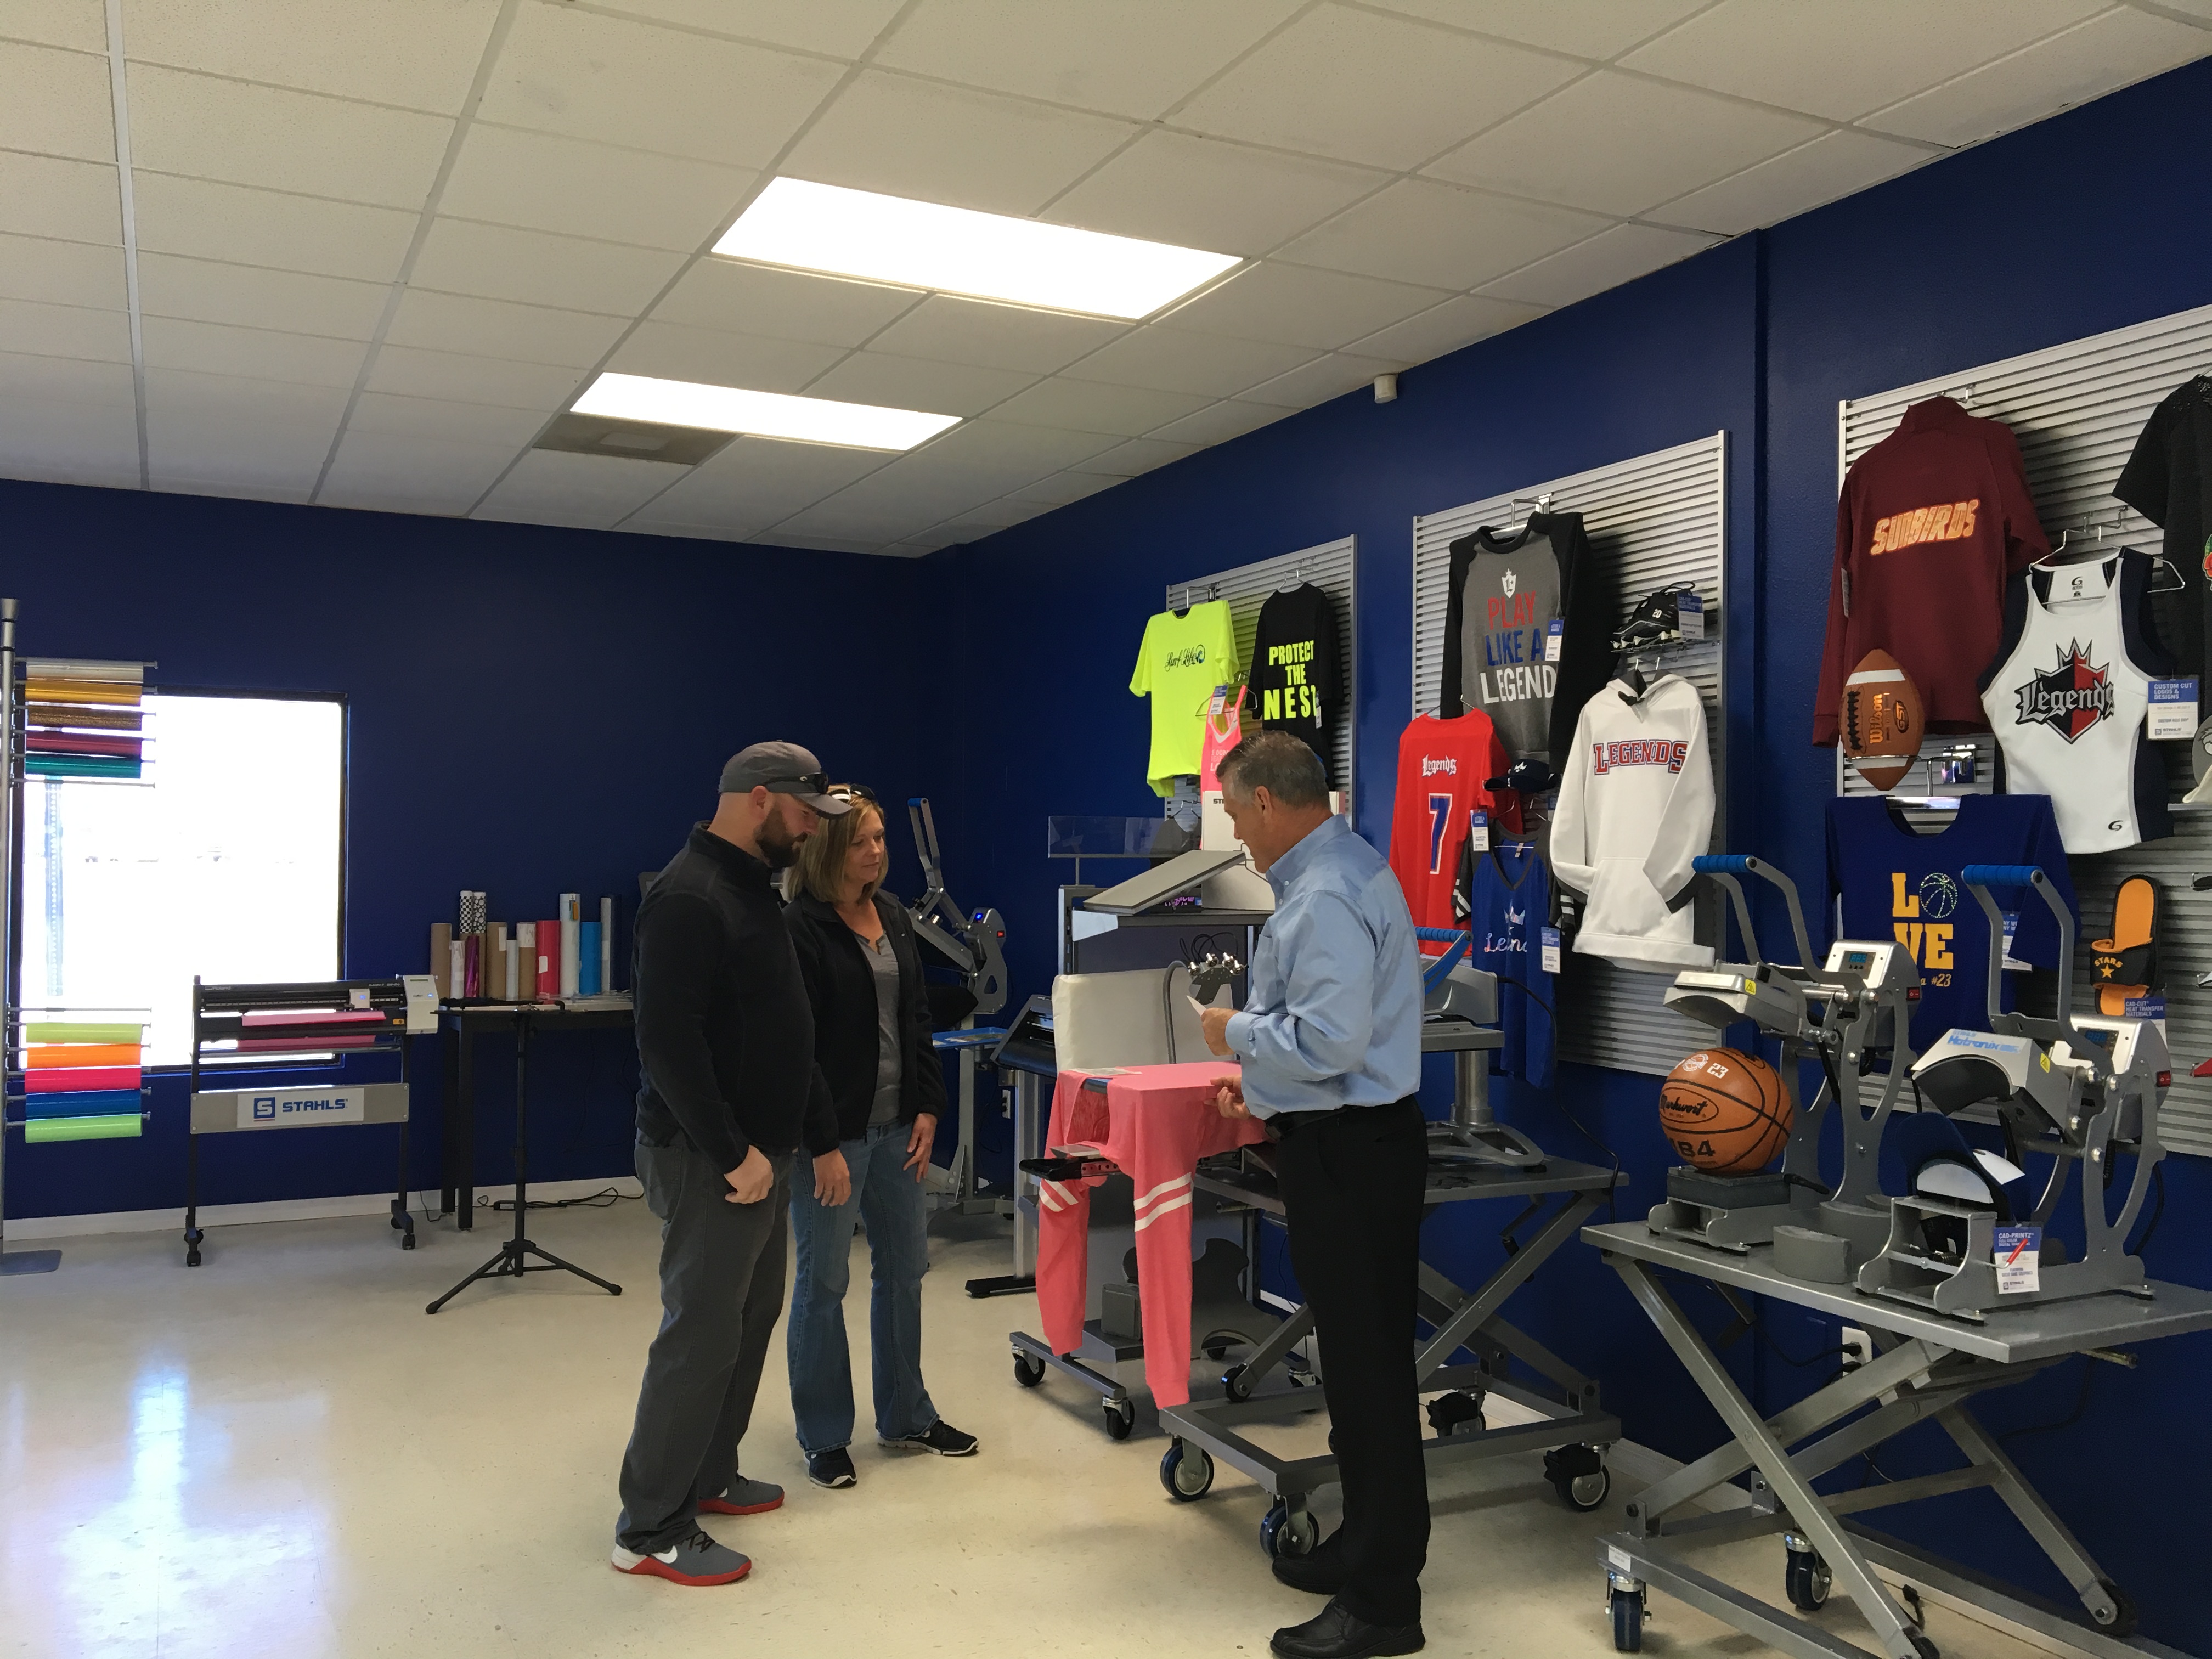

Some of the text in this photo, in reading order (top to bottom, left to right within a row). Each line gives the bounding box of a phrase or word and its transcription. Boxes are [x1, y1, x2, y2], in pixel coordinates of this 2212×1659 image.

[1870, 499, 1980, 555] SUNBIRDS
[1487, 590, 1536, 630] PLAY
[1652, 608, 1662, 619] 20
[1269, 640, 1314, 665] PROTECT
[1485, 628, 1545, 667] LIKE A
[1285, 663, 1306, 686] THE
[1480, 665, 1557, 704] LEGEND
[1263, 685, 1317, 720] NEST
[1869, 694, 1883, 744] Wilson
[2014, 679, 2115, 725] Legends
[1422, 754, 1457, 777] Legends
[1593, 740, 1689, 775] LEGENDS
[1428, 793, 1453, 874] 7
[1931, 973, 1951, 987] #23
[2094, 957, 2123, 968] STARS
[1706, 1063, 1729, 1079] 23
